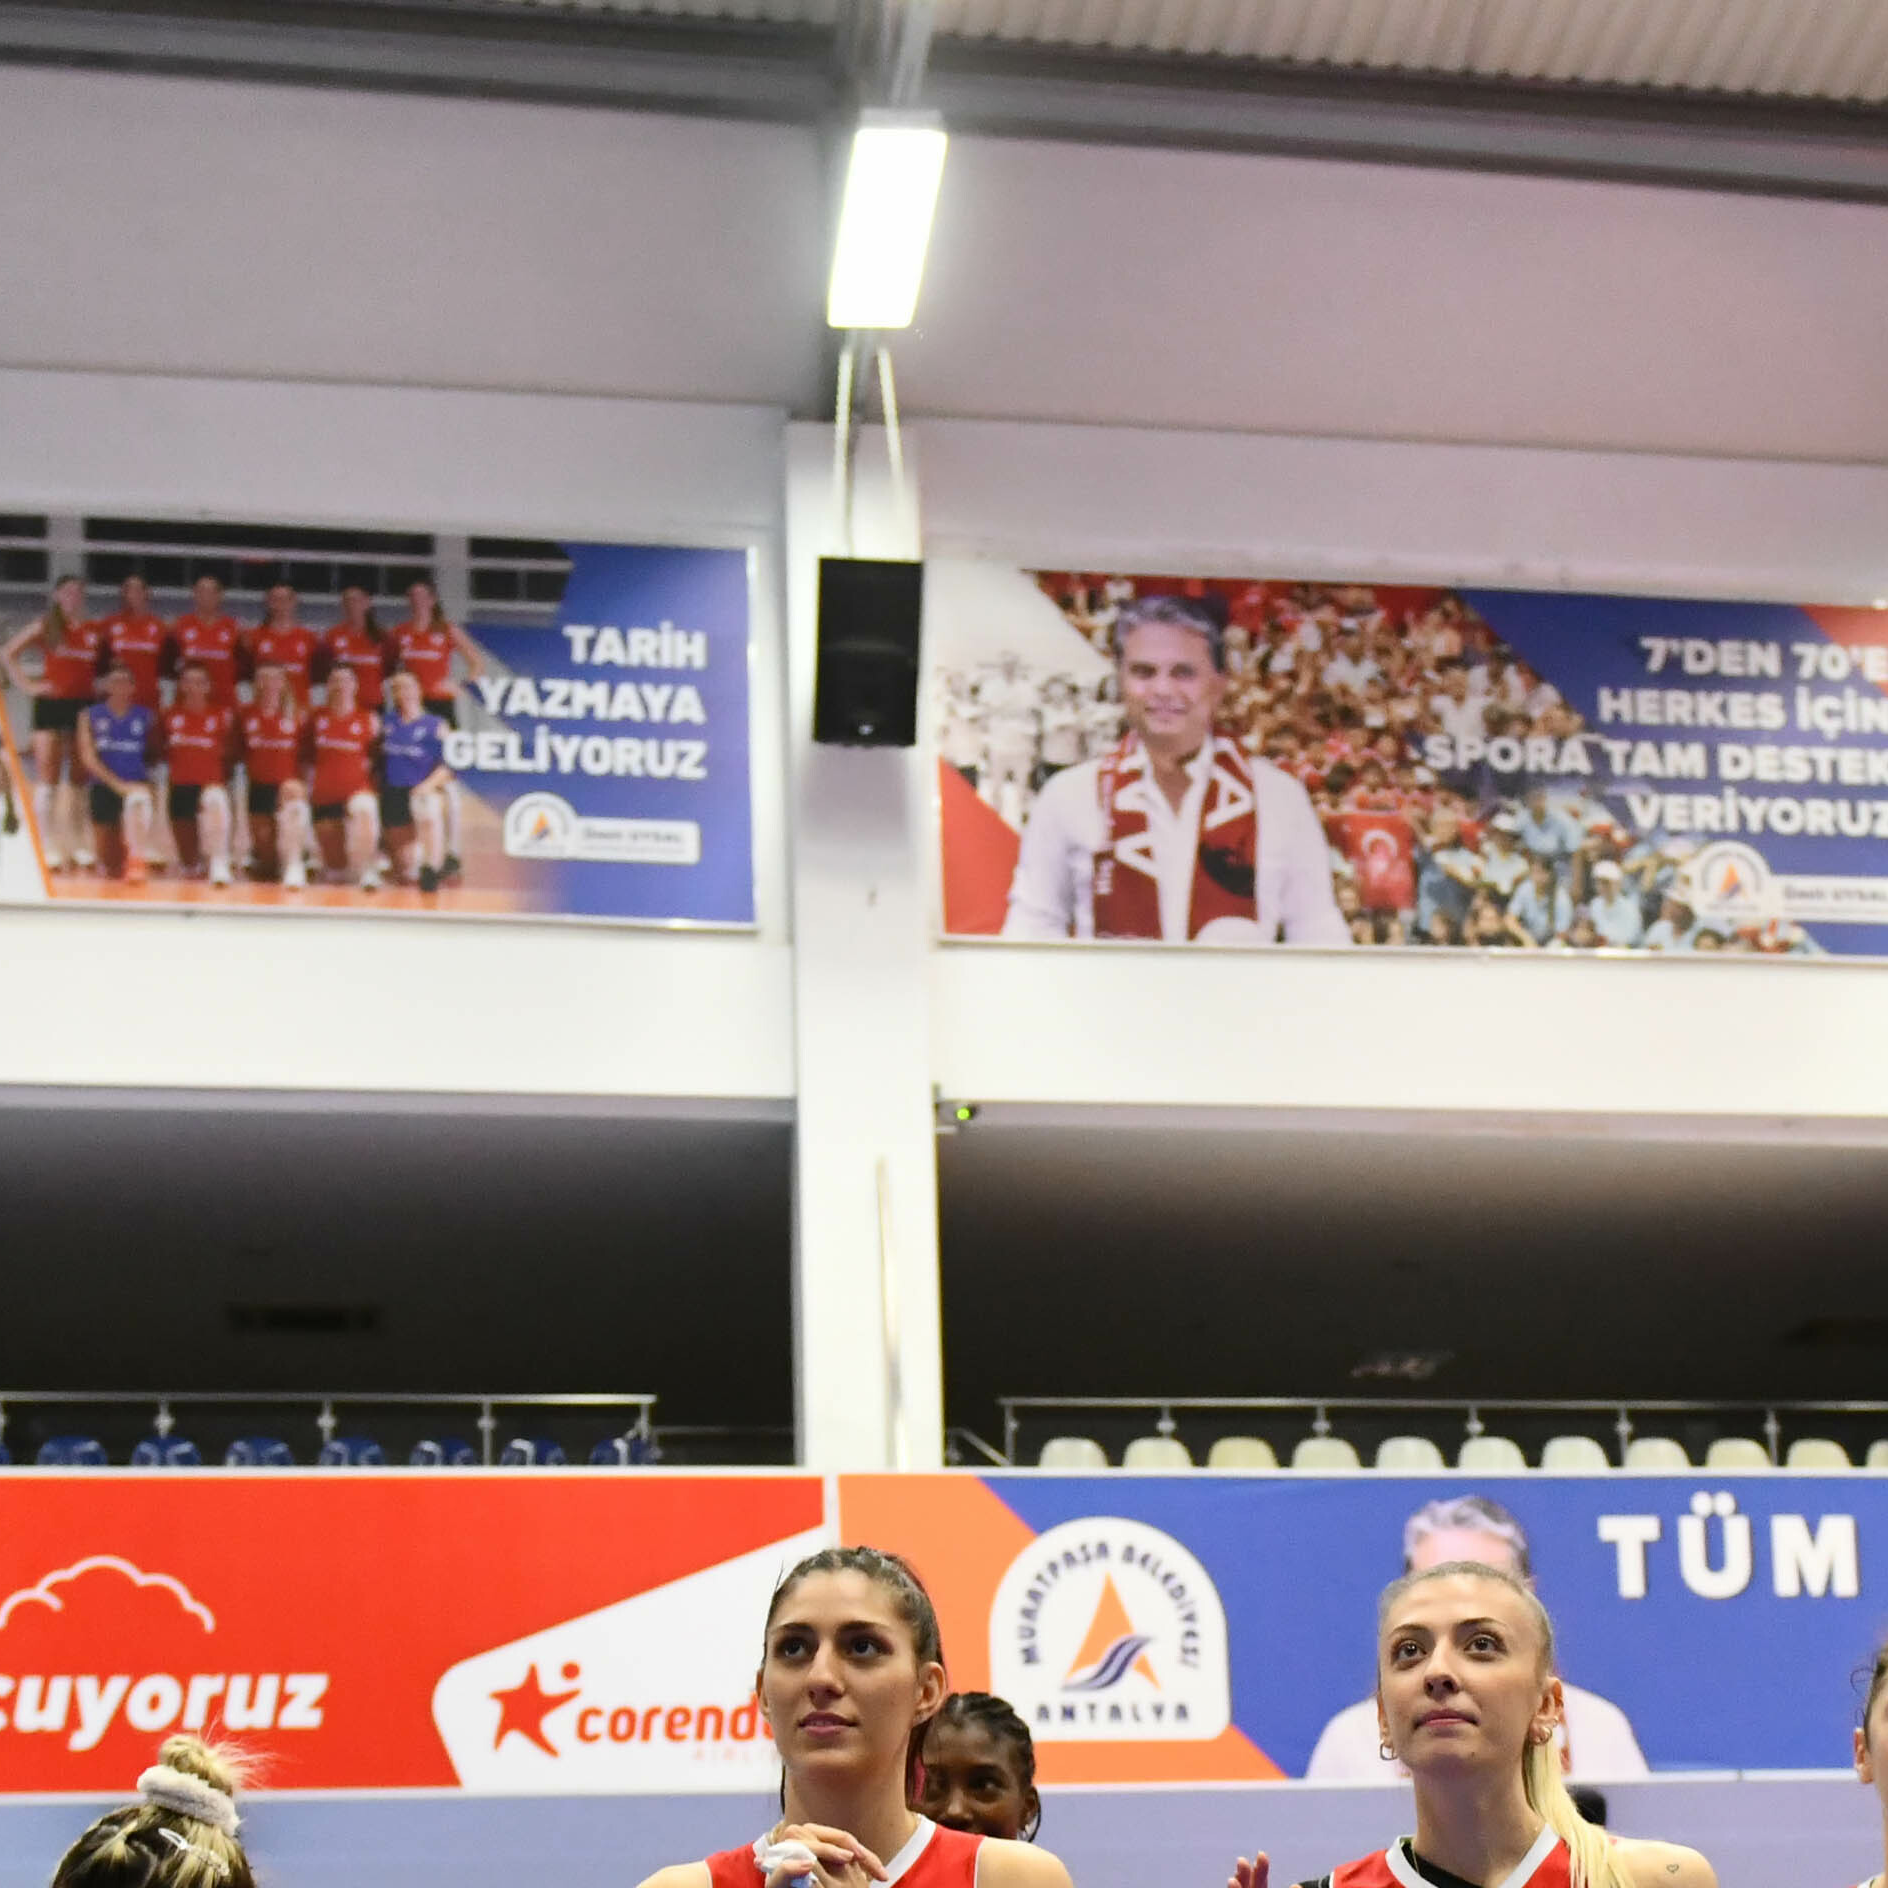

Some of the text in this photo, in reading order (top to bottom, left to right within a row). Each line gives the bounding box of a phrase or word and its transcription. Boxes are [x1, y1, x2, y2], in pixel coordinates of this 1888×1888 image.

[562, 620, 707, 670] TARİH
[1640, 637, 1780, 679] 7'DEN
[477, 675, 707, 725] YAZMAYA
[1598, 687, 1786, 730] HERKES
[443, 723, 708, 780] GELİYORUZ
[1425, 735, 1593, 775] SPORA
[1608, 741, 1706, 778] TAM
[1597, 1491, 1860, 1599] TÜM
[576, 1690, 782, 1743] corend
[1037, 1704, 1189, 1722] ANTALYA
